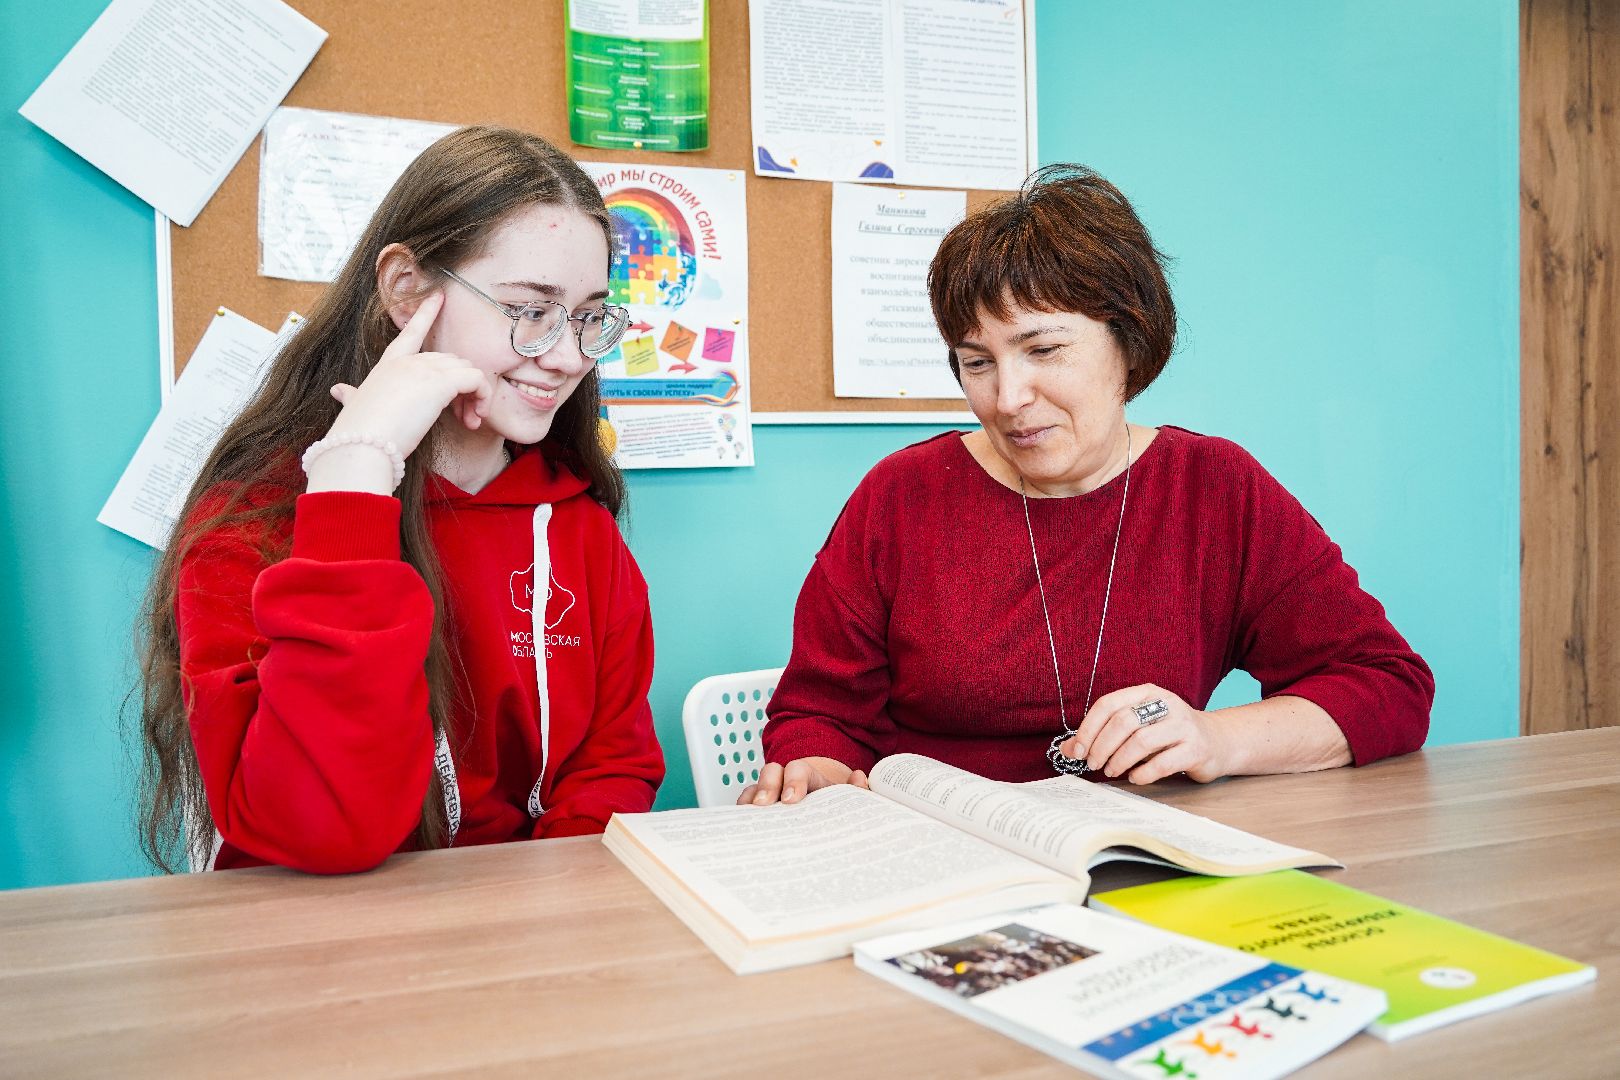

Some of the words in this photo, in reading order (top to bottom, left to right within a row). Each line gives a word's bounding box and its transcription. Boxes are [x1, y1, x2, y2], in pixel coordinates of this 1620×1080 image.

[599, 172, 616, 188] ир
[620, 169, 646, 182] мы
[649, 171, 702, 210] строим
[695, 210, 722, 261] сами!
[858, 220, 893, 233] Галина
[849, 255, 891, 266] советник
[633, 389, 663, 397] СВОЕМУ
[510, 630, 581, 647] МОСВСКАЯ
[512, 644, 553, 659] ОБЛАЬ
